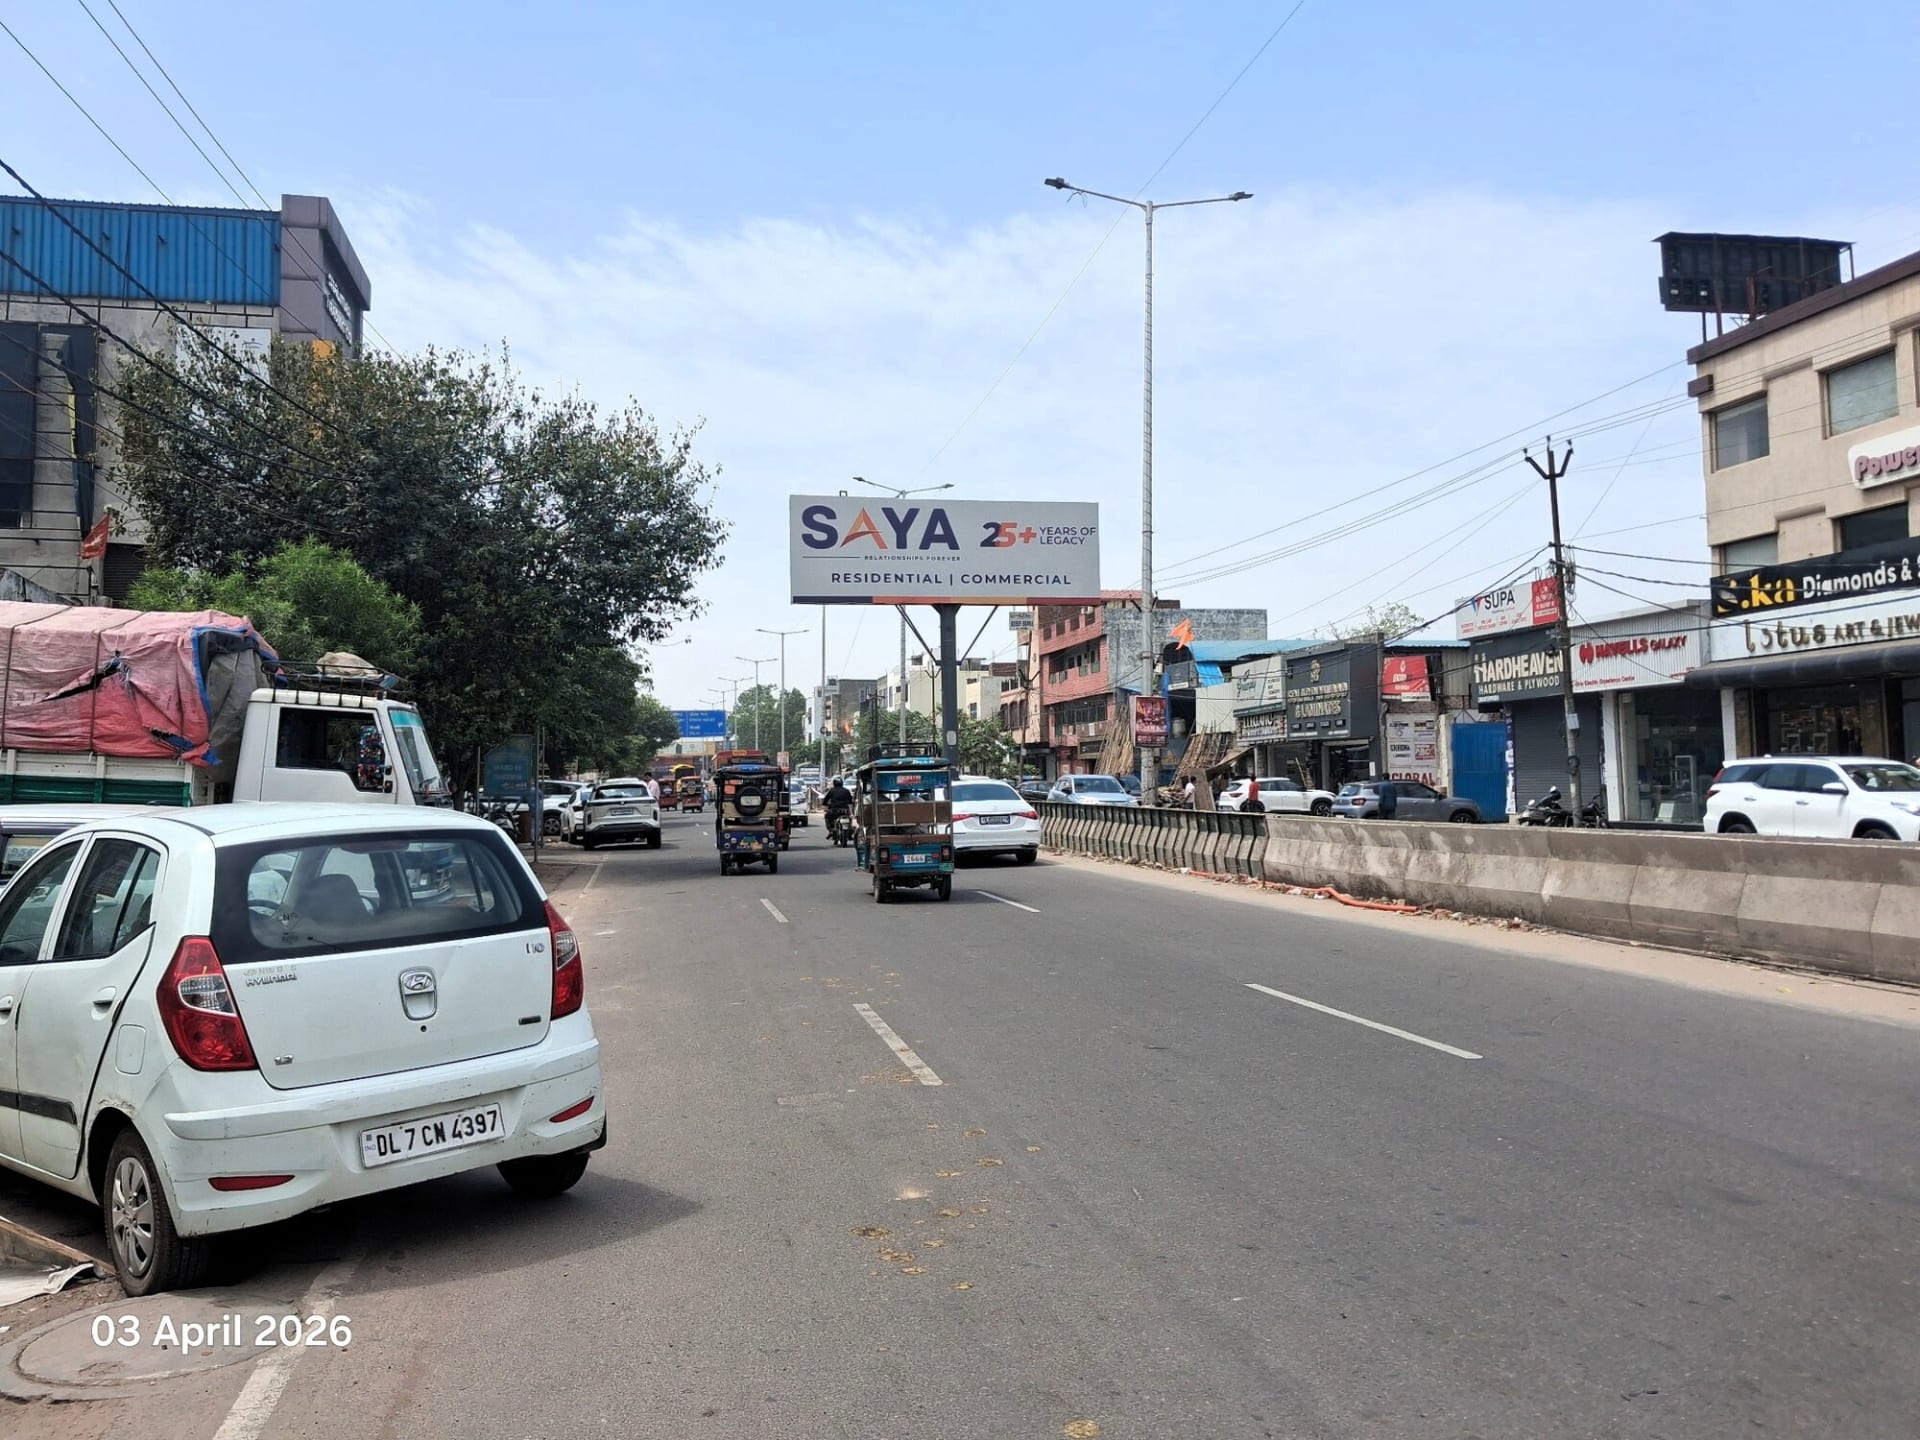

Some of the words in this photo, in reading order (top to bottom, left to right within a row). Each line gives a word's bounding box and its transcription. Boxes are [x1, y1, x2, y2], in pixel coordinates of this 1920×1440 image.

[801, 505, 960, 550] SAYA
[980, 521, 1037, 548] 25+
[1040, 526, 1077, 536] YEARS
[1080, 526, 1097, 536] OF
[1040, 536, 1085, 545] LEGACY
[831, 572, 943, 584] RESIDENTIAL
[960, 573, 1072, 585] COMMERCIAL
[1803, 560, 1897, 599] Diamonds
[1901, 557, 1912, 581] &
[1484, 589, 1515, 610] SUPA
[1834, 621, 1866, 641] ART
[1870, 618, 1884, 637] &
[1595, 637, 1649, 659] HAVELLS
[1650, 635, 1687, 652] GALAXY
[1473, 650, 1564, 683] HARDHEAVEN
[1478, 681, 1515, 695] HARDWARE
[1518, 680, 1522, 690] &
[1524, 675, 1560, 691] PLYWOOD
[376, 1132, 401, 1157] DL
[404, 1127, 415, 1151] 7
[421, 1121, 447, 1147] CN
[451, 1110, 498, 1140] 4397
